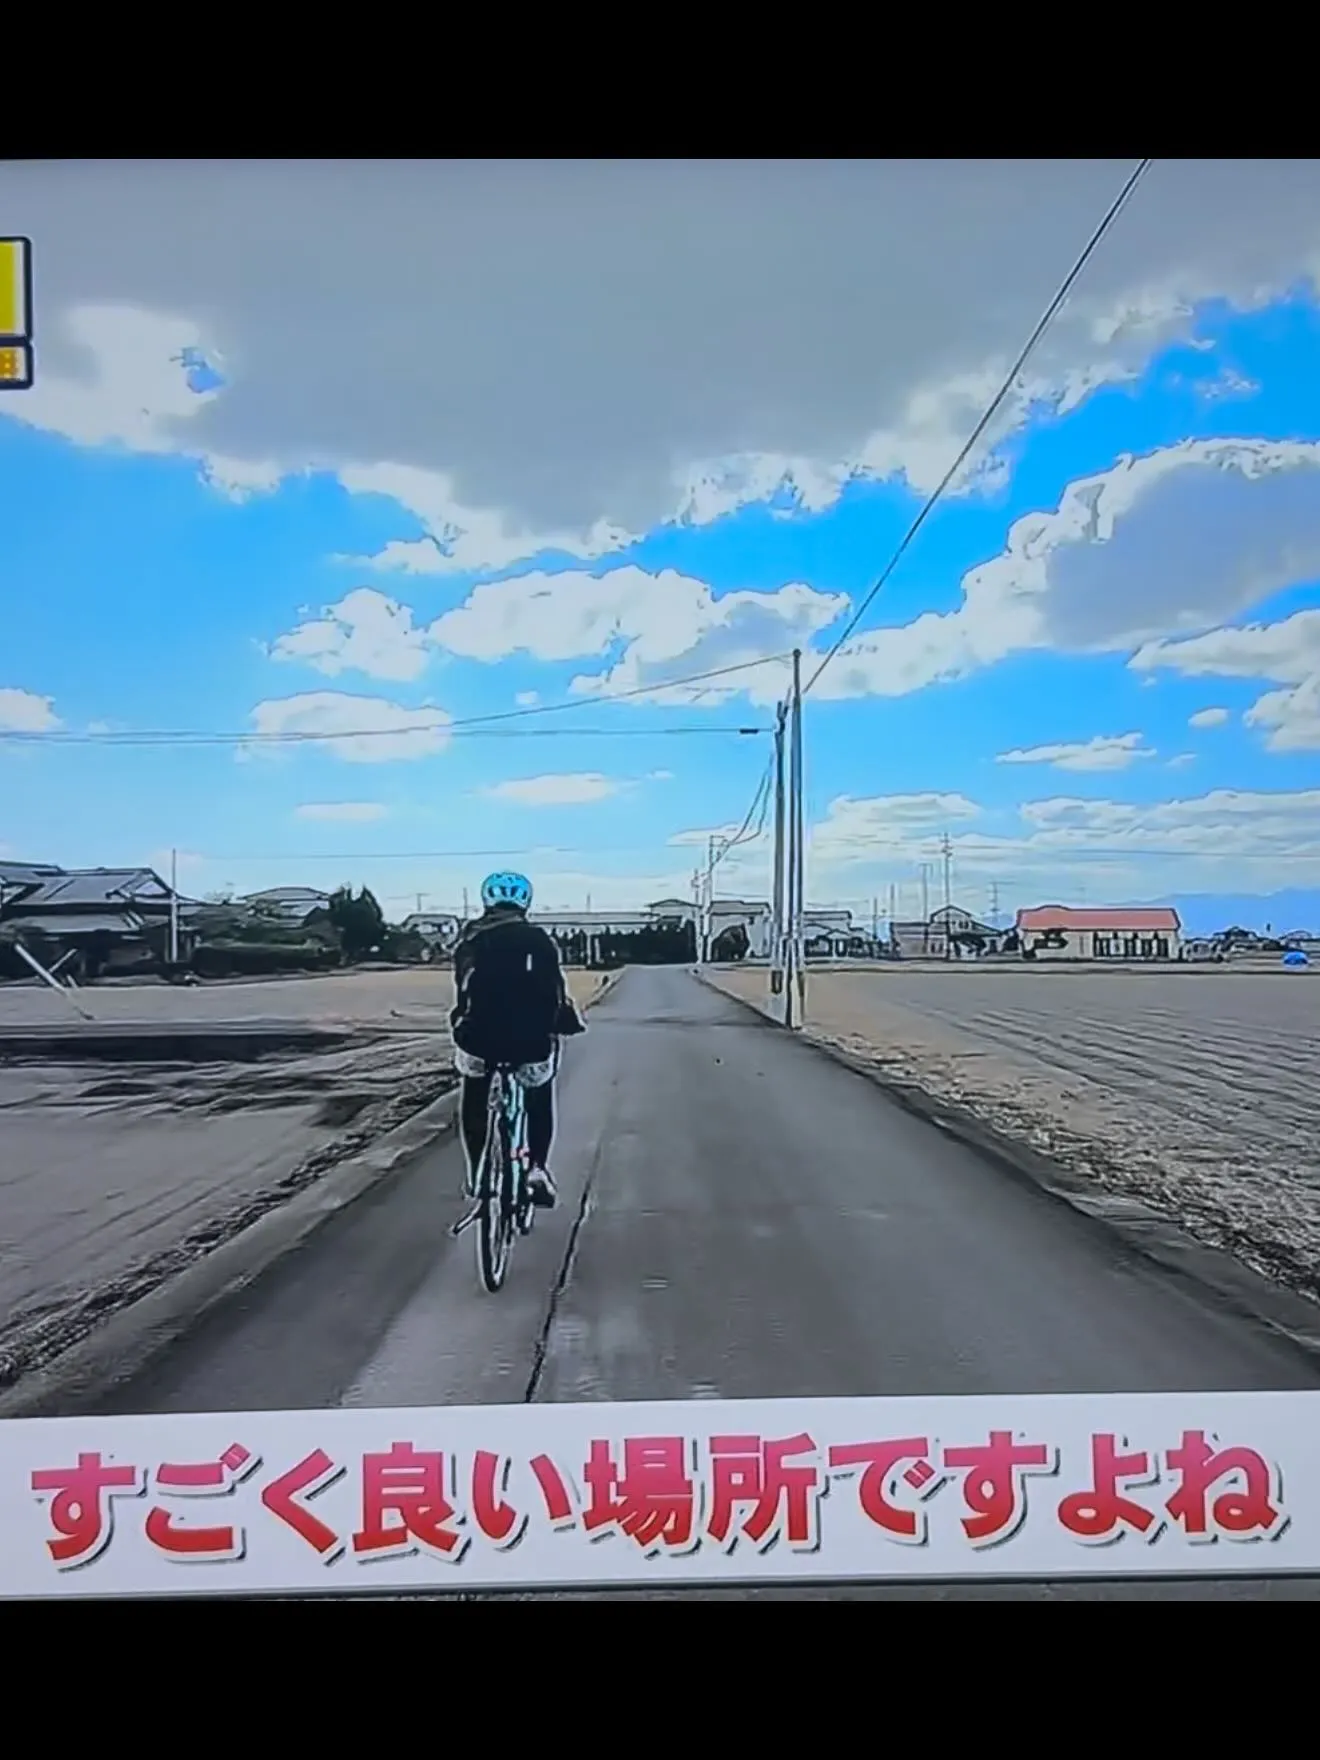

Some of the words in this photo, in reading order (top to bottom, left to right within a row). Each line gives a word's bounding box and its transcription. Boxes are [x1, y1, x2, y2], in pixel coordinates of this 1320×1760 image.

[31, 1431, 1281, 1563] すごく良い場所ですよね
